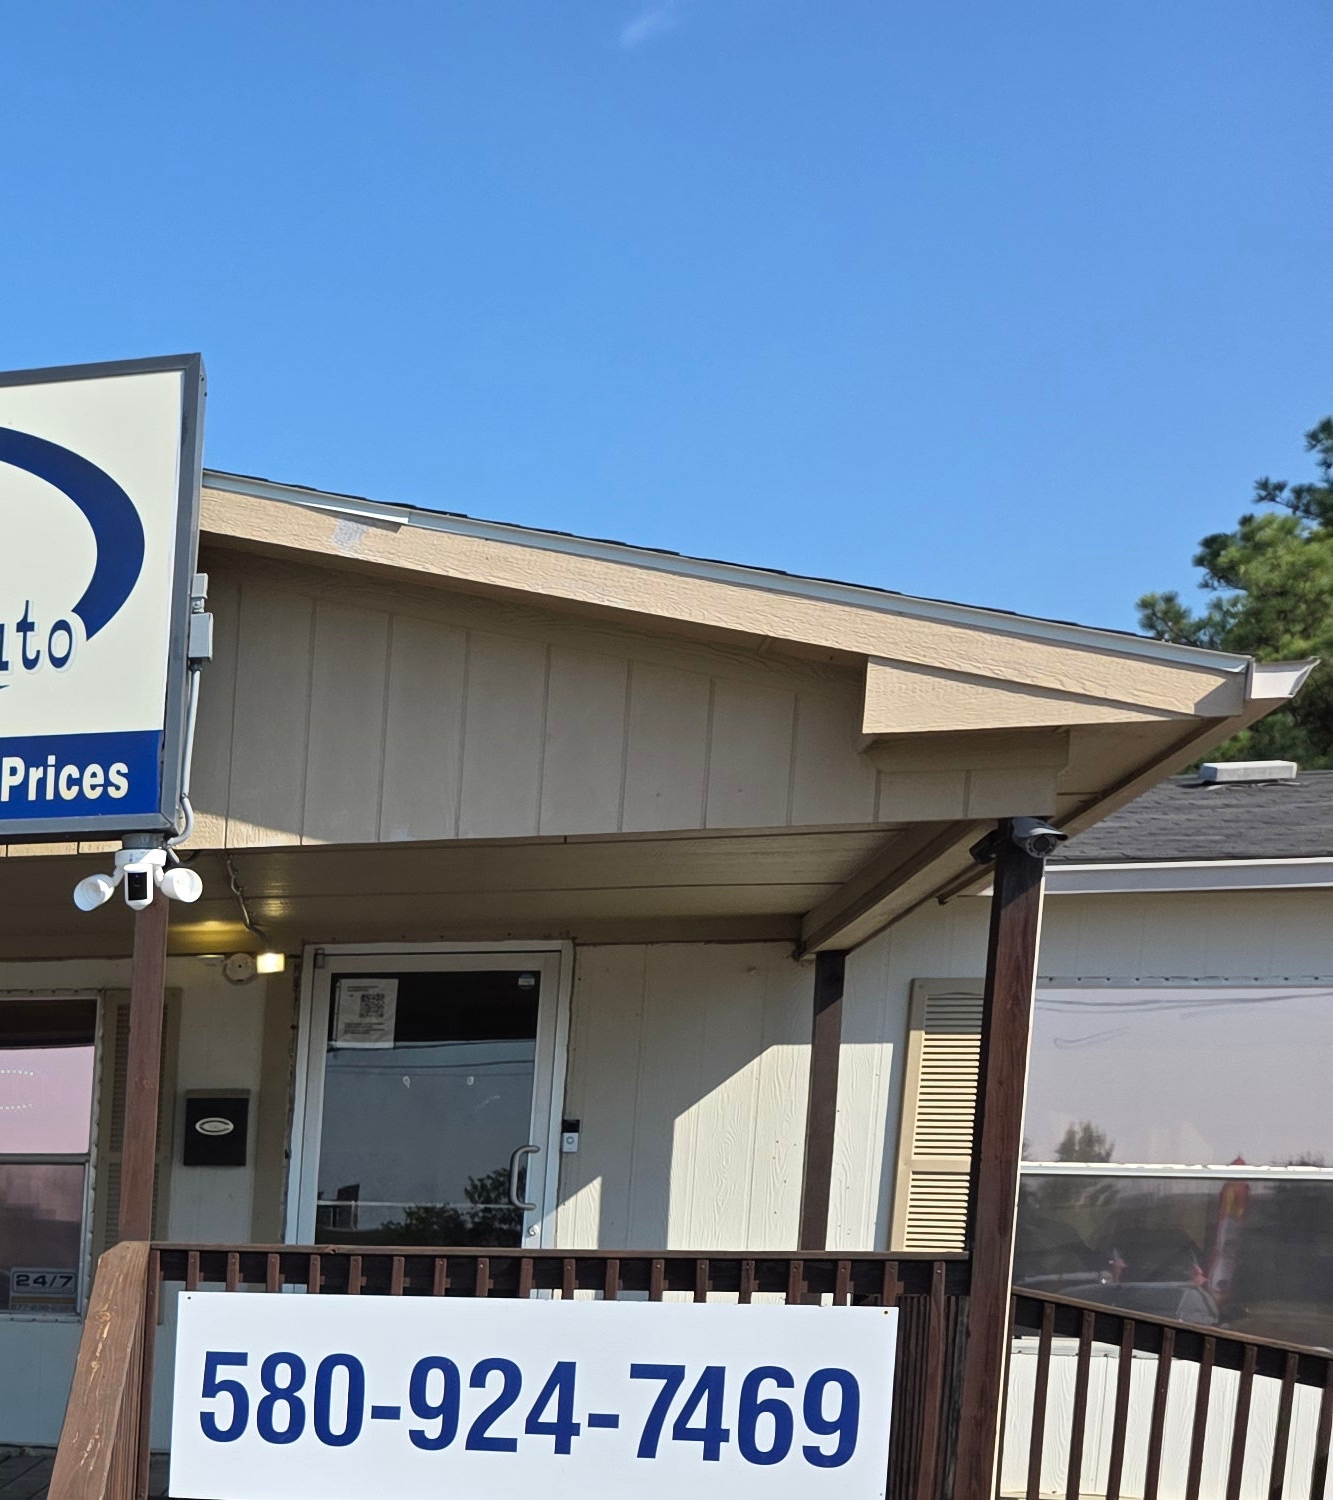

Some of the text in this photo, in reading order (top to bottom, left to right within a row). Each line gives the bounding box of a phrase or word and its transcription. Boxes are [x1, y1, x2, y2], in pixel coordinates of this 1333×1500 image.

[0, 755, 130, 803] Prices
[16, 1274, 73, 1287] 24/7
[198, 1350, 862, 1469] 580-924-7469
